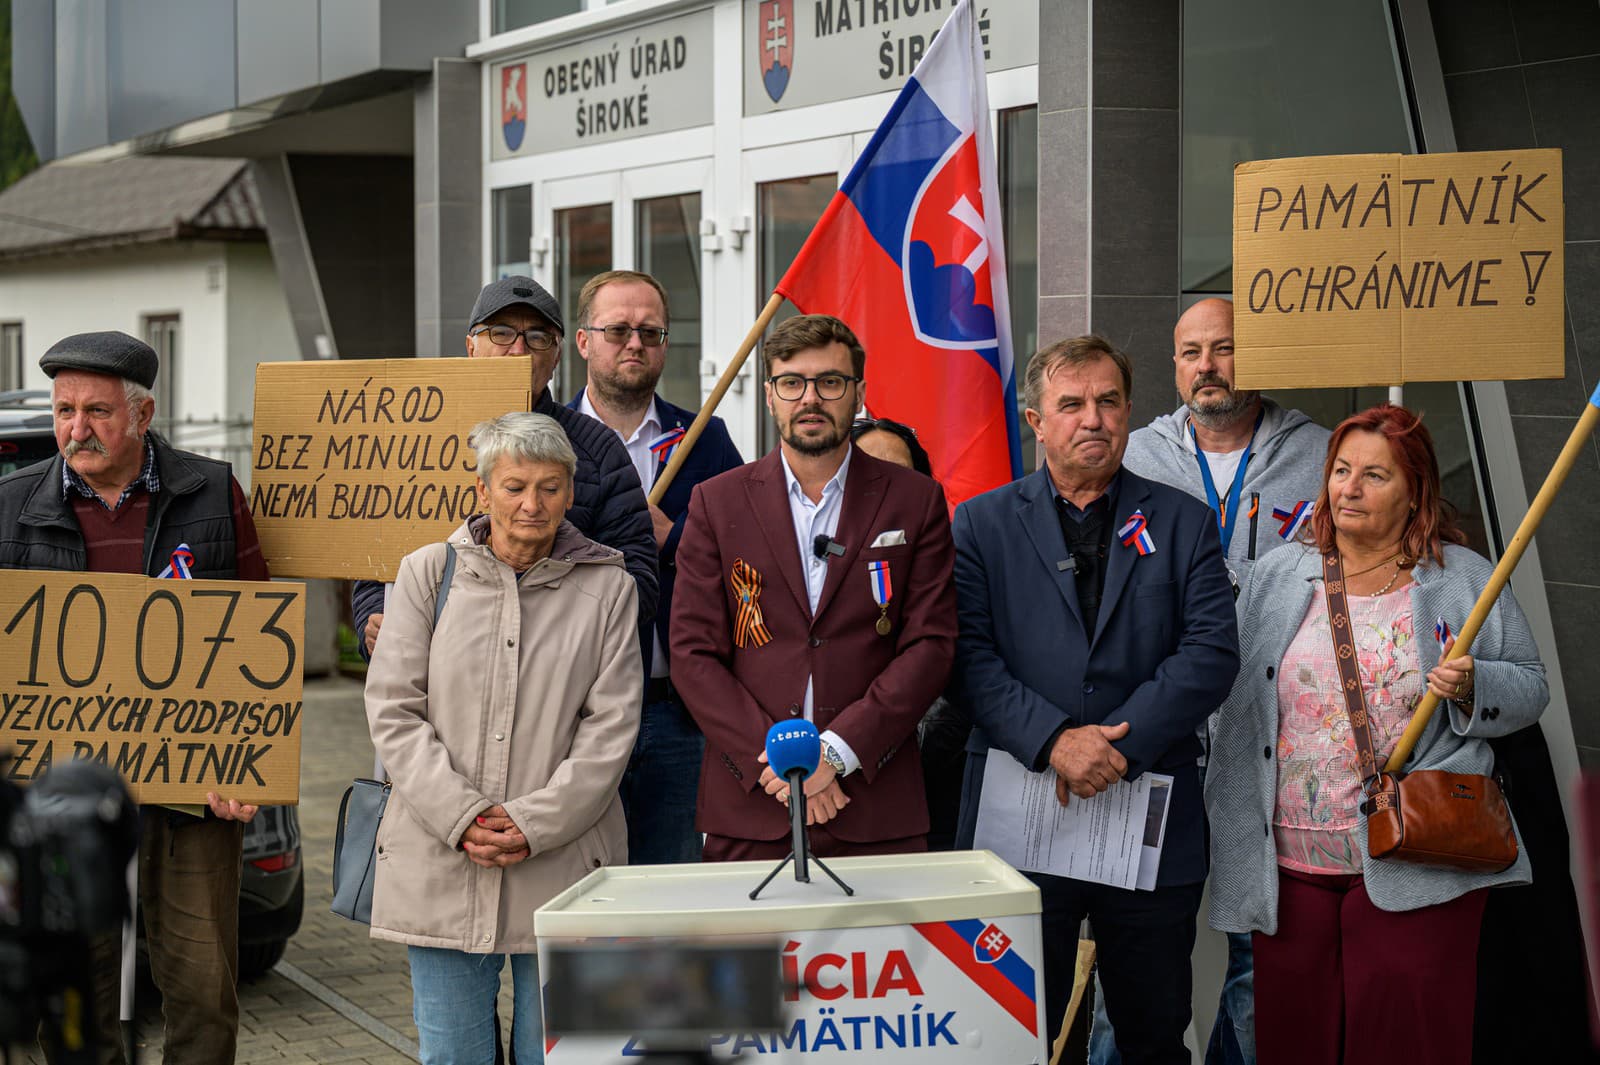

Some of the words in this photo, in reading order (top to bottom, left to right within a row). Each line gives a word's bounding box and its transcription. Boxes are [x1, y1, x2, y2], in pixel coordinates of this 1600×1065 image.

[544, 43, 619, 98] OBECNÝ
[631, 36, 686, 79] ÚRAD
[879, 8, 990, 80] ŠIRÉ
[576, 84, 648, 137] ŠIROKÉ
[1254, 161, 1548, 232] PAMÄTNÍK
[1249, 251, 1502, 313] OCHRÁNIME
[317, 377, 444, 424] NÁROD
[254, 434, 313, 470] BEZ
[323, 434, 478, 472] MINULOS
[251, 473, 325, 518] NEMÁ
[327, 475, 482, 522] BUDÚCNO
[0, 683, 153, 733] YZICKÝCH
[8, 739, 53, 780] ZA
[782, 939, 924, 1002] ÍCIA
